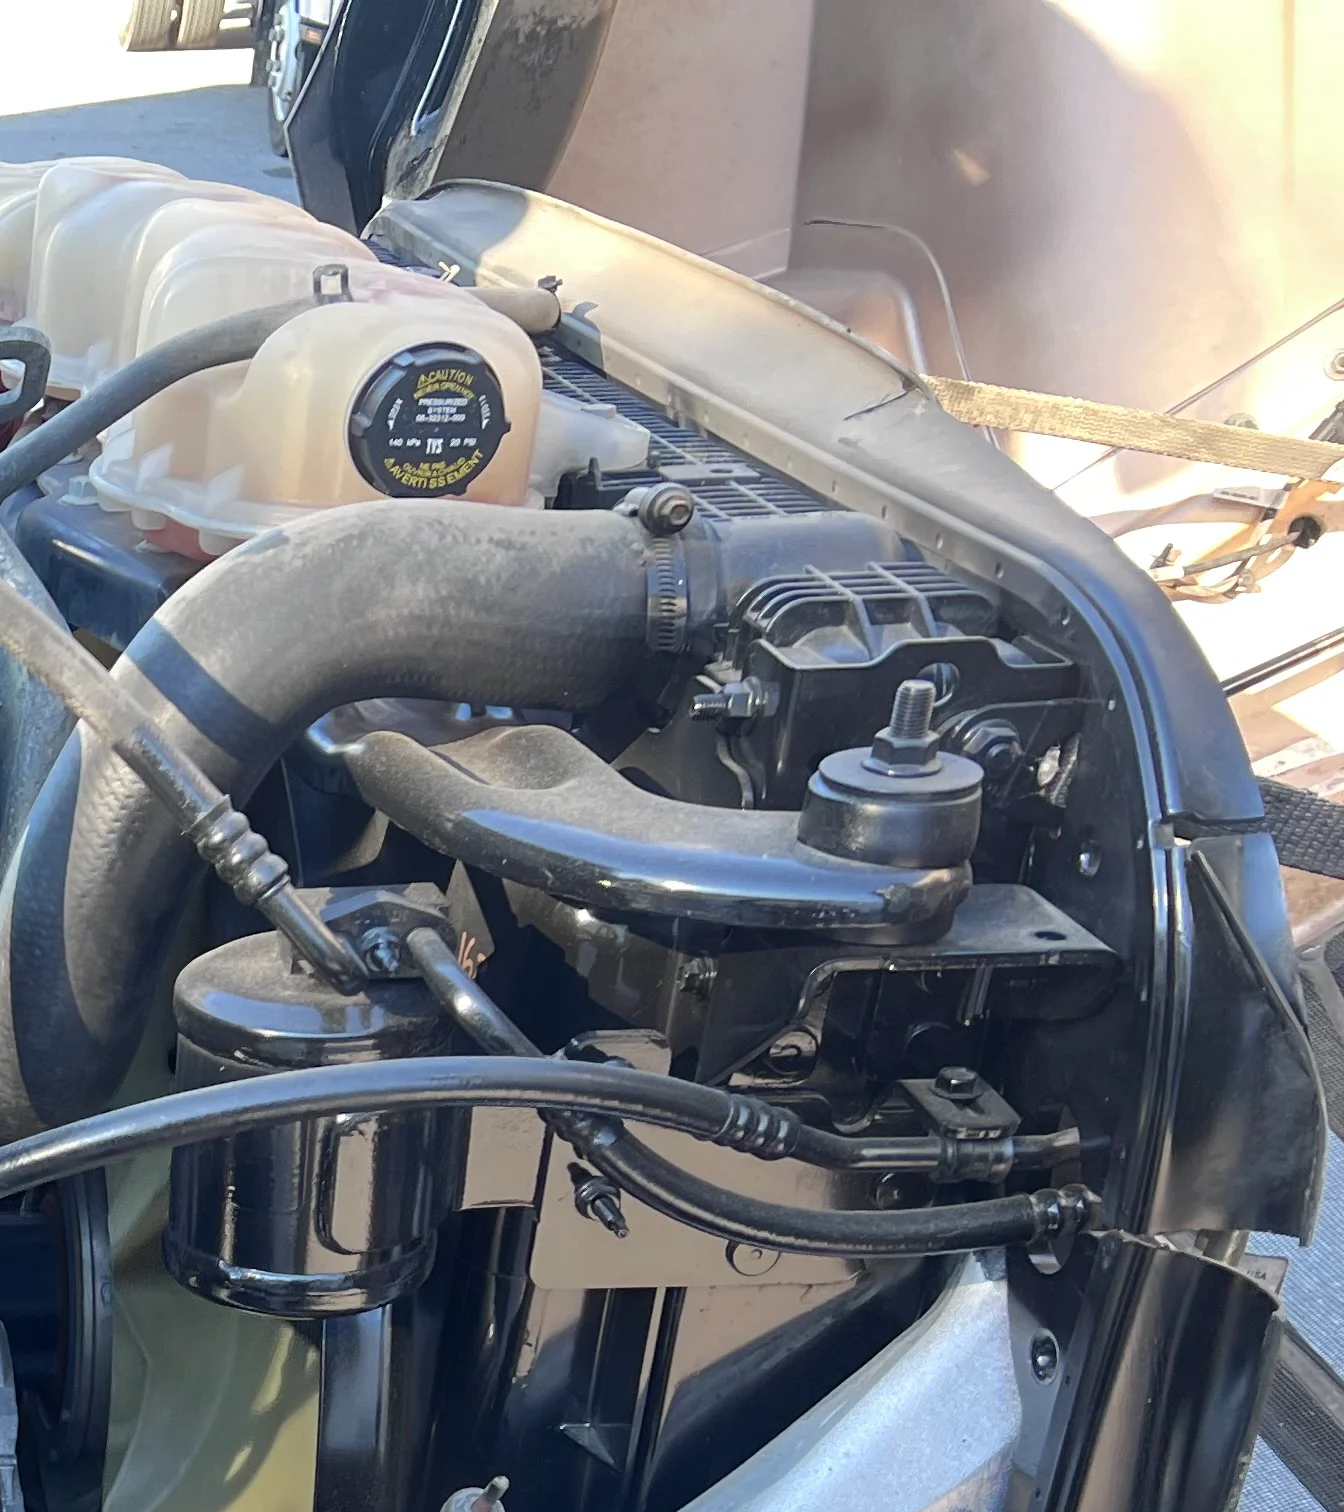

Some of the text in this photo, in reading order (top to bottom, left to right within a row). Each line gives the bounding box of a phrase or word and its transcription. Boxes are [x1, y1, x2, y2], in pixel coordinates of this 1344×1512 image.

[427, 368, 475, 387] CAUTION
[417, 397, 469, 407] PRESSURIZED
[426, 406, 458, 415] SYSTEM
[388, 437, 404, 447] 140
[425, 437, 445, 455] TVS
[449, 437, 462, 447] 20
[462, 437, 477, 447] PSI
